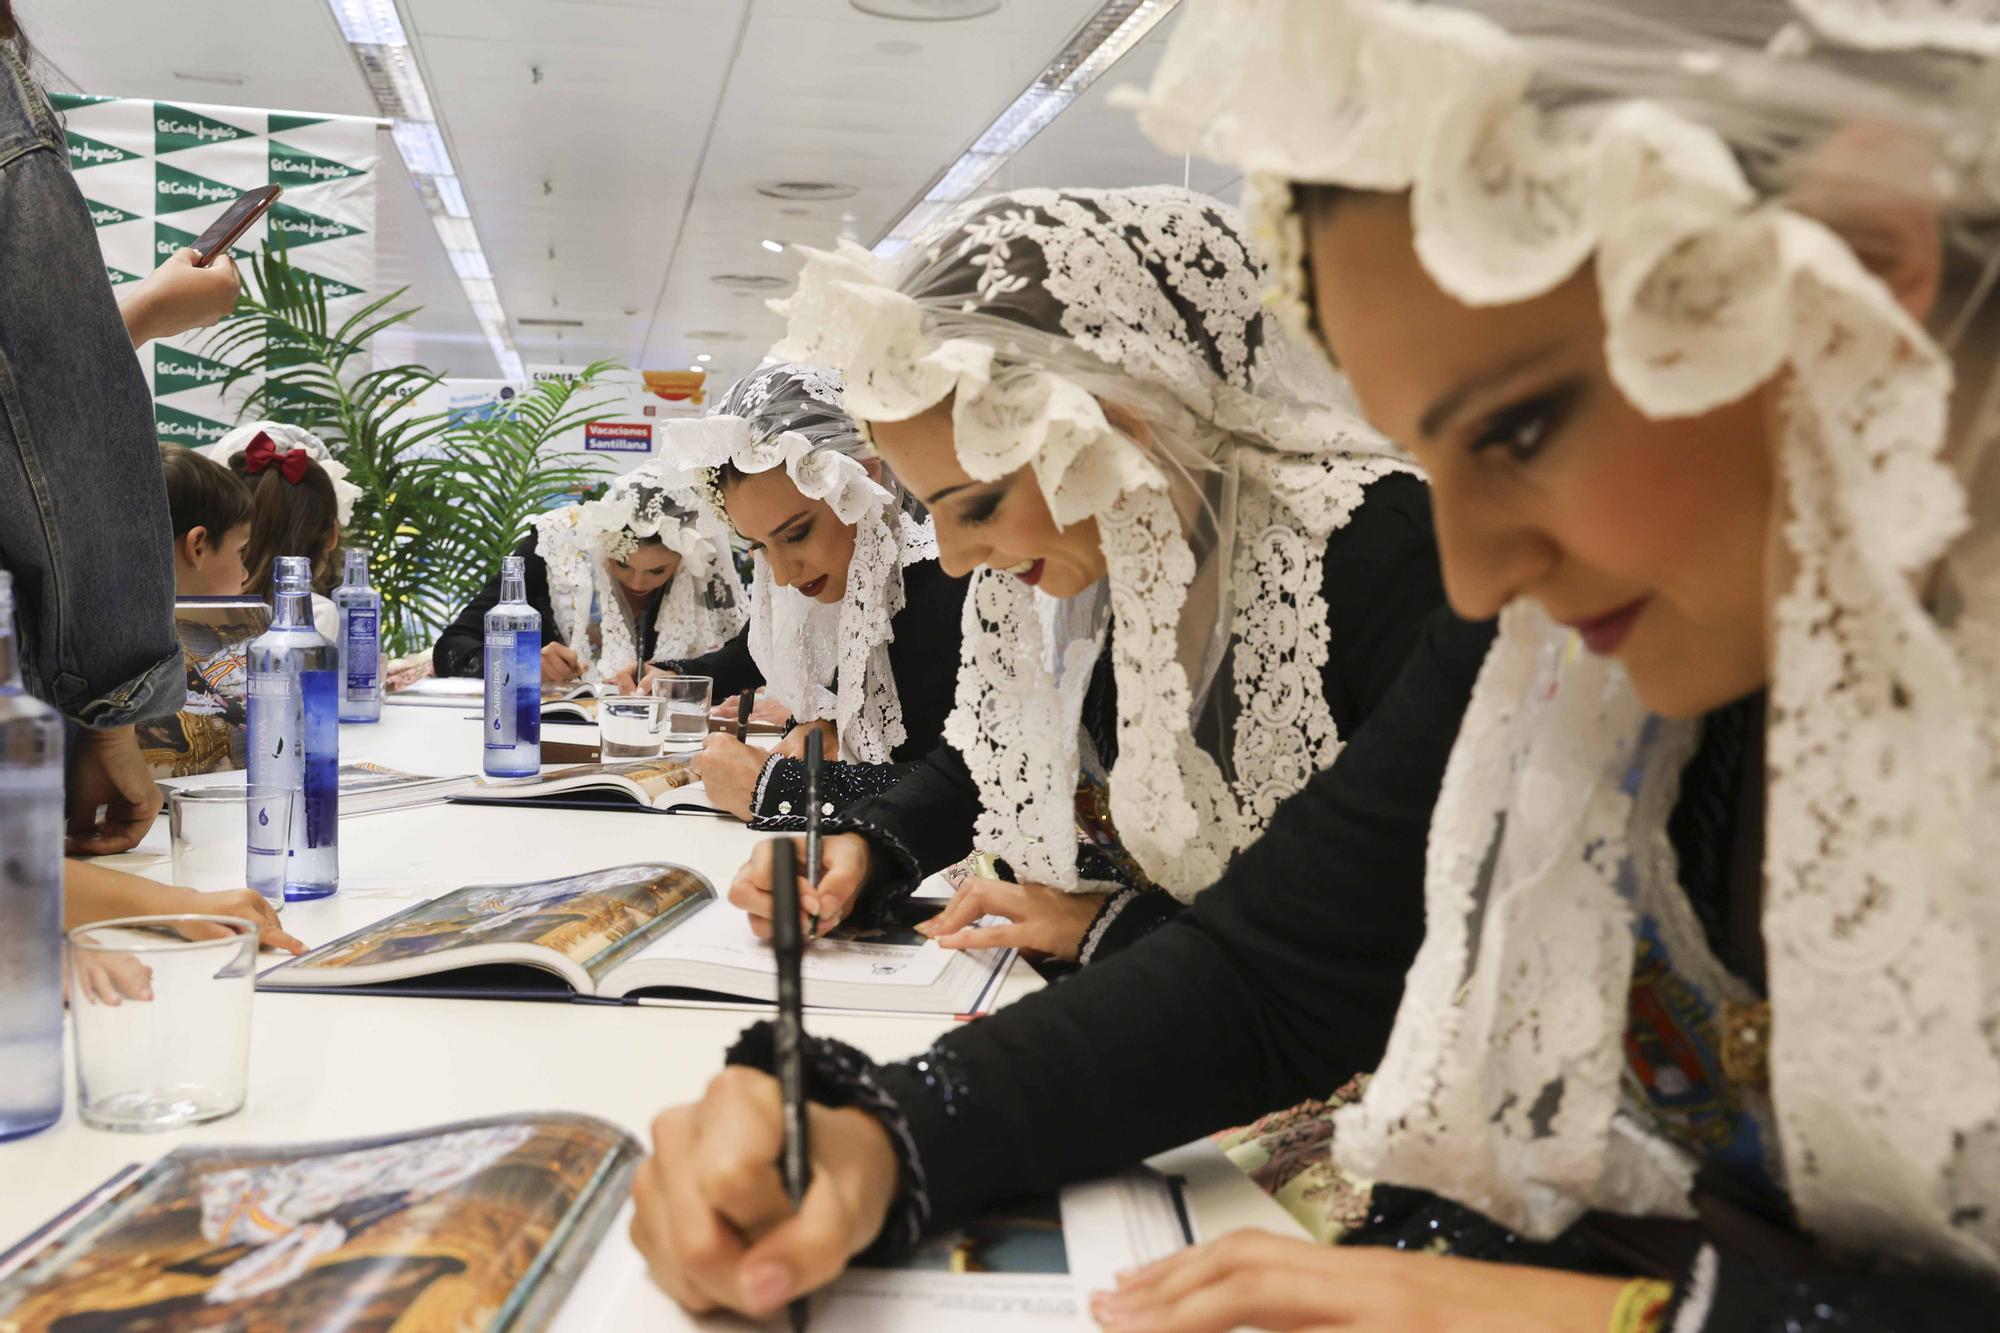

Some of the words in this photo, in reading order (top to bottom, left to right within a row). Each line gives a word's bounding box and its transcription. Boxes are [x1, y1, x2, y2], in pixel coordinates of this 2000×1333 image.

[157, 119, 169, 133] El
[170, 122, 197, 135] Corte
[157, 180, 169, 194] El
[170, 183, 197, 197] Corte
[156, 361, 168, 375] El
[169, 362, 196, 376] Corte
[157, 421, 168, 435] El
[169, 422, 196, 436] Corte
[589, 425, 648, 437] Vacaciones
[588, 438, 647, 451] Santillana
